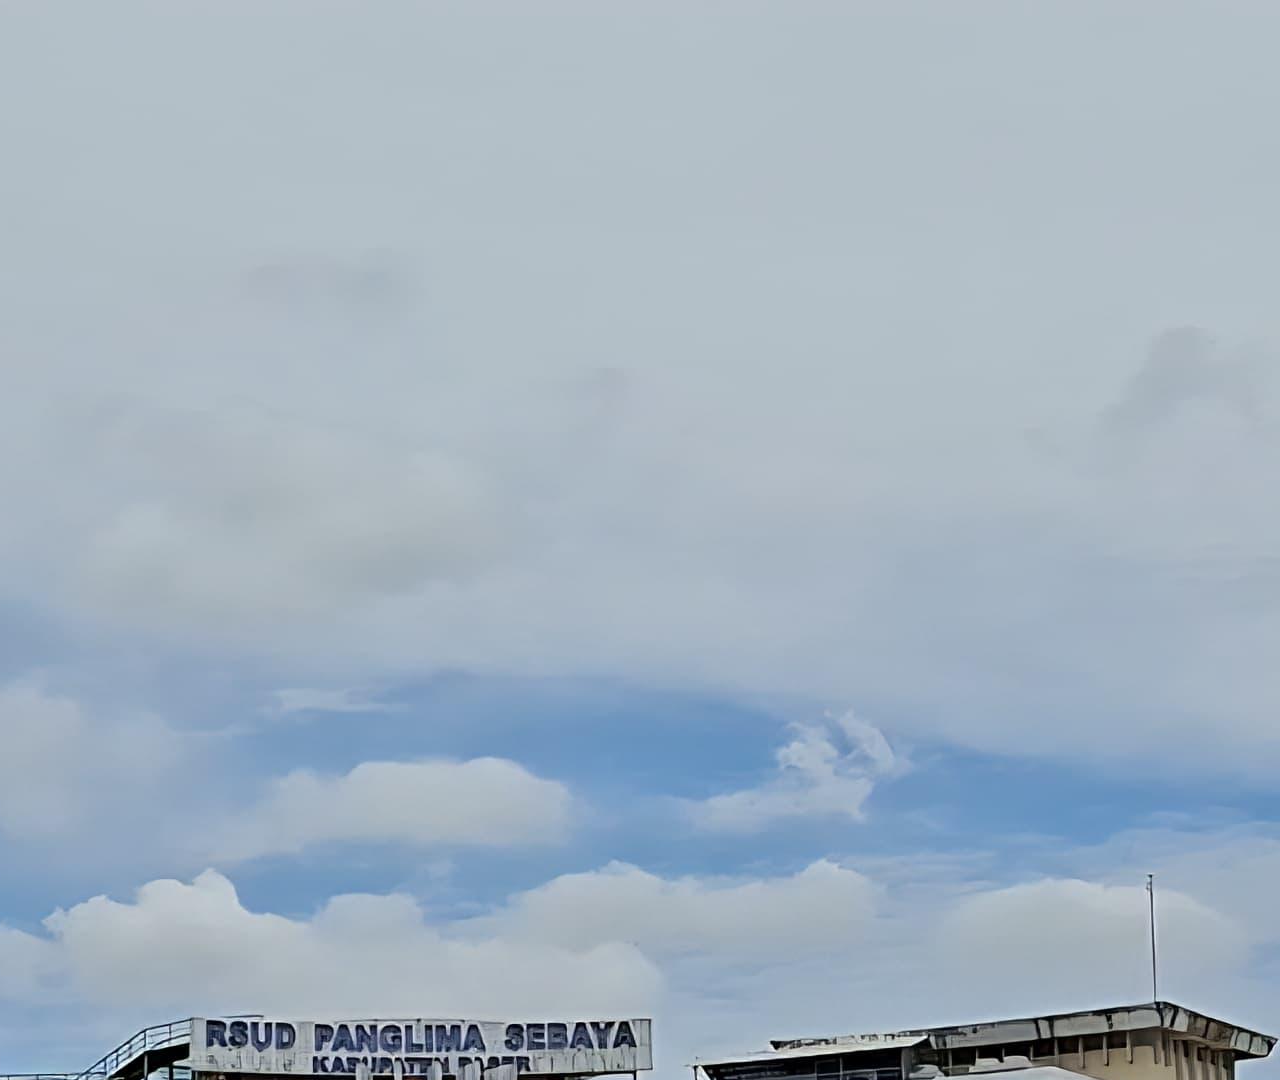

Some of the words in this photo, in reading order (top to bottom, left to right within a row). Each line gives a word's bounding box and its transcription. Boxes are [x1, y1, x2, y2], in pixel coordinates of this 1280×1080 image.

[206, 1020, 297, 1051] RSUD
[314, 1022, 487, 1053] PANGLIMA
[504, 1021, 638, 1050] SEBAYA
